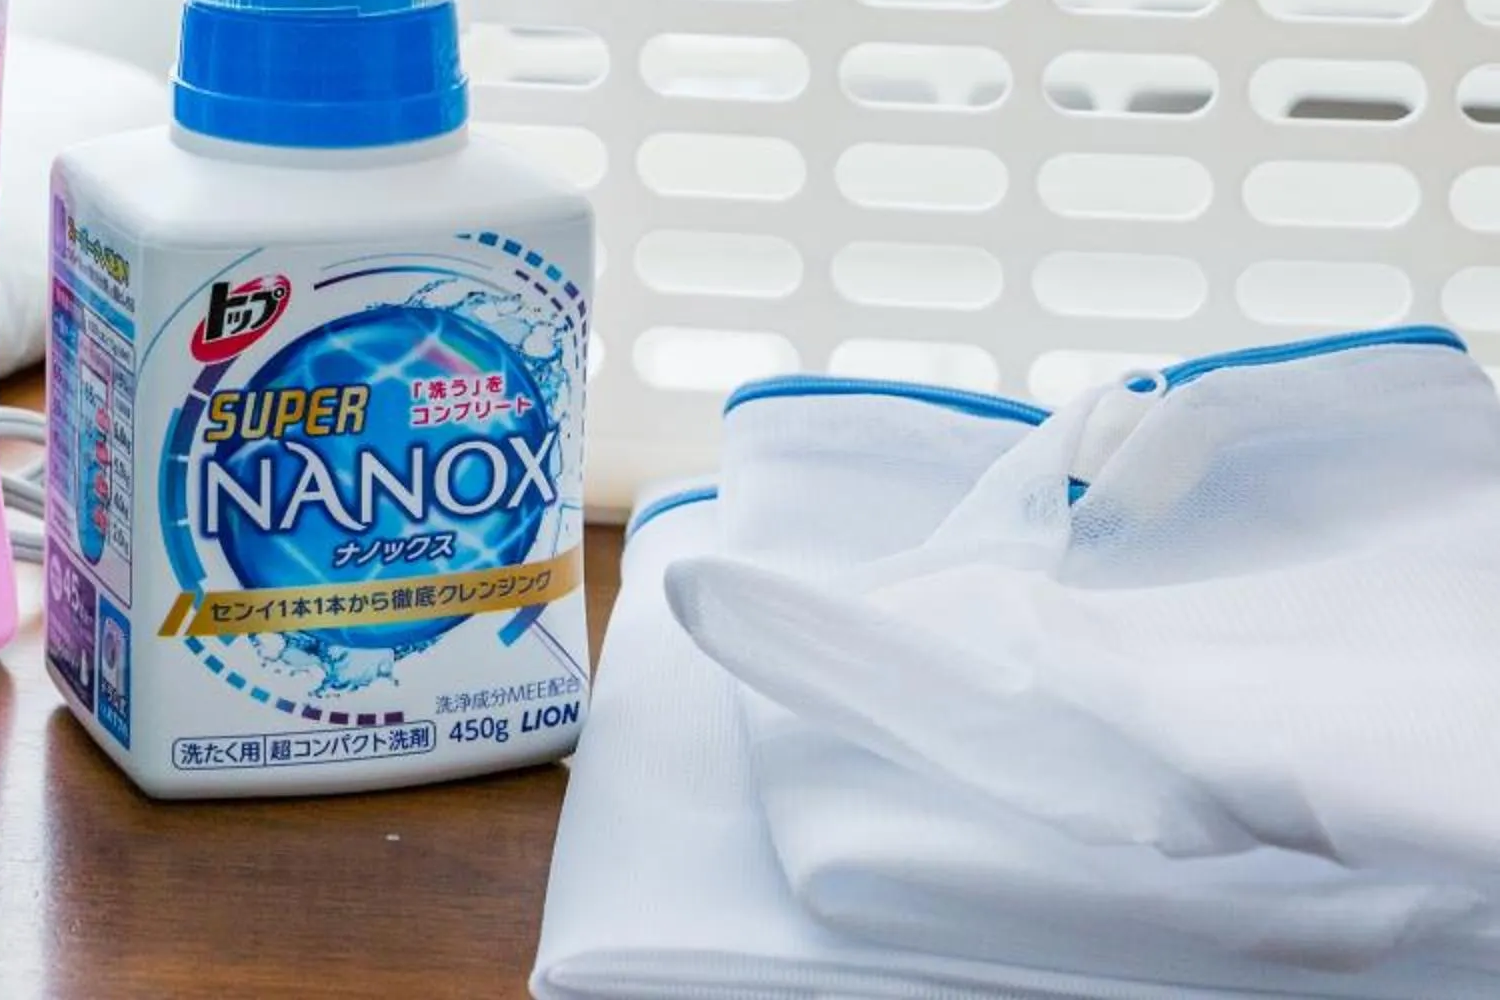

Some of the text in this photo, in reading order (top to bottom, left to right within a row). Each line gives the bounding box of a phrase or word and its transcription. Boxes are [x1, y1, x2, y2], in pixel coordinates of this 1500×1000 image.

[205, 281, 285, 341] トップ
[205, 384, 369, 442] SUPER
[205, 434, 557, 534] NANOX
[333, 533, 456, 569] ナノックス
[211, 570, 552, 622] センイ1本1本から徹底クレンジング
[180, 726, 431, 765] 洗たく用 超コンパクト洗剤
[449, 700, 581, 743] 450g LION
